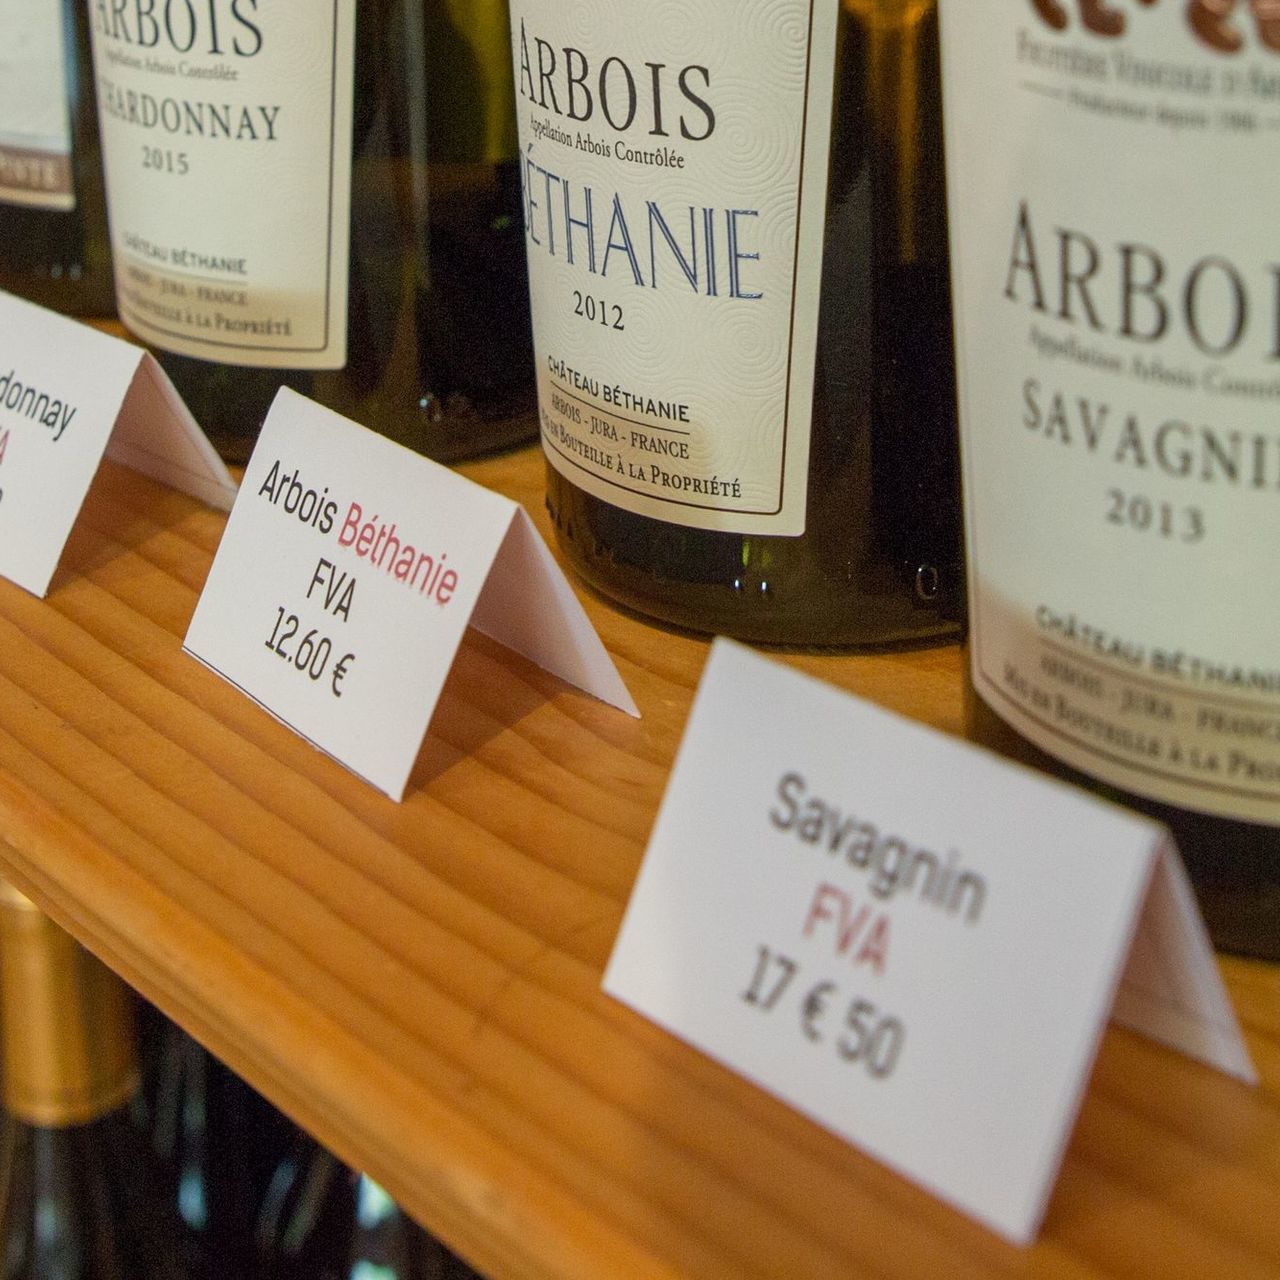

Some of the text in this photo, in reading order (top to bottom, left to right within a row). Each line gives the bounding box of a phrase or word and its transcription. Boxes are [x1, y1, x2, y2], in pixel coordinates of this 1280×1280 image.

[520, 17, 716, 141] ARBOIS
[141, 145, 190, 176] 2015
[575, 131, 611, 158] Arbois
[614, 141, 685, 168] Contrôlée
[170, 246, 248, 275] BÉTHANIE
[573, 290, 625, 331] 2012
[548, 355, 690, 423] CHÂTEAU BÉTHANIE
[551, 392, 582, 425] ARBOIS
[590, 415, 618, 442] JURA
[630, 430, 690, 460] FRANCE
[559, 421, 613, 471] BOUTEILLE
[628, 462, 646, 482] LA
[651, 464, 741, 499] PROPRIÉTÉ
[259, 460, 460, 607] Arbois Béthanie
[1106, 487, 1206, 544] 2013
[306, 558, 358, 623] FVA
[264, 606, 356, 698] 12.60 €
[769, 772, 988, 928] Savagnin
[803, 883, 891, 975] FVA
[740, 945, 907, 1082] 17 € 50
